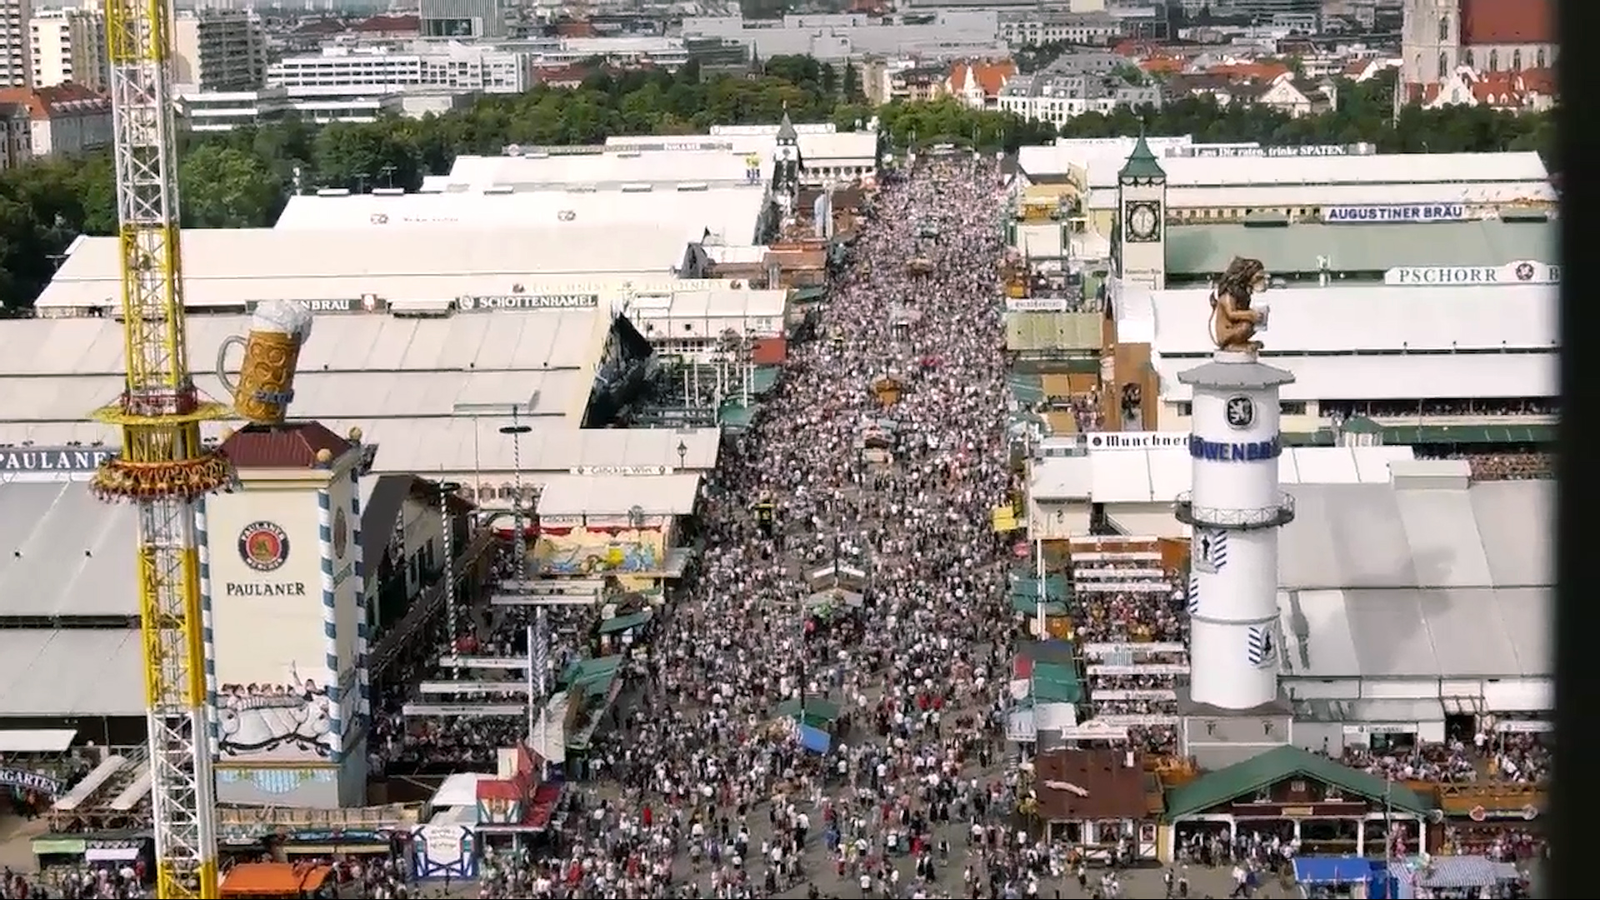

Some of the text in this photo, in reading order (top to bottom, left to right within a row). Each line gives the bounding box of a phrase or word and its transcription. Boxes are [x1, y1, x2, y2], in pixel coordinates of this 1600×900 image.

[1268, 145, 1298, 156] trinke
[1300, 144, 1346, 156] SPATEN.
[1328, 208, 1421, 220] AUGUSTINER
[1399, 267, 1498, 283] PSCHORR
[479, 294, 596, 309] SCHOTTENHAMEL
[226, 581, 306, 596] PAULANER
